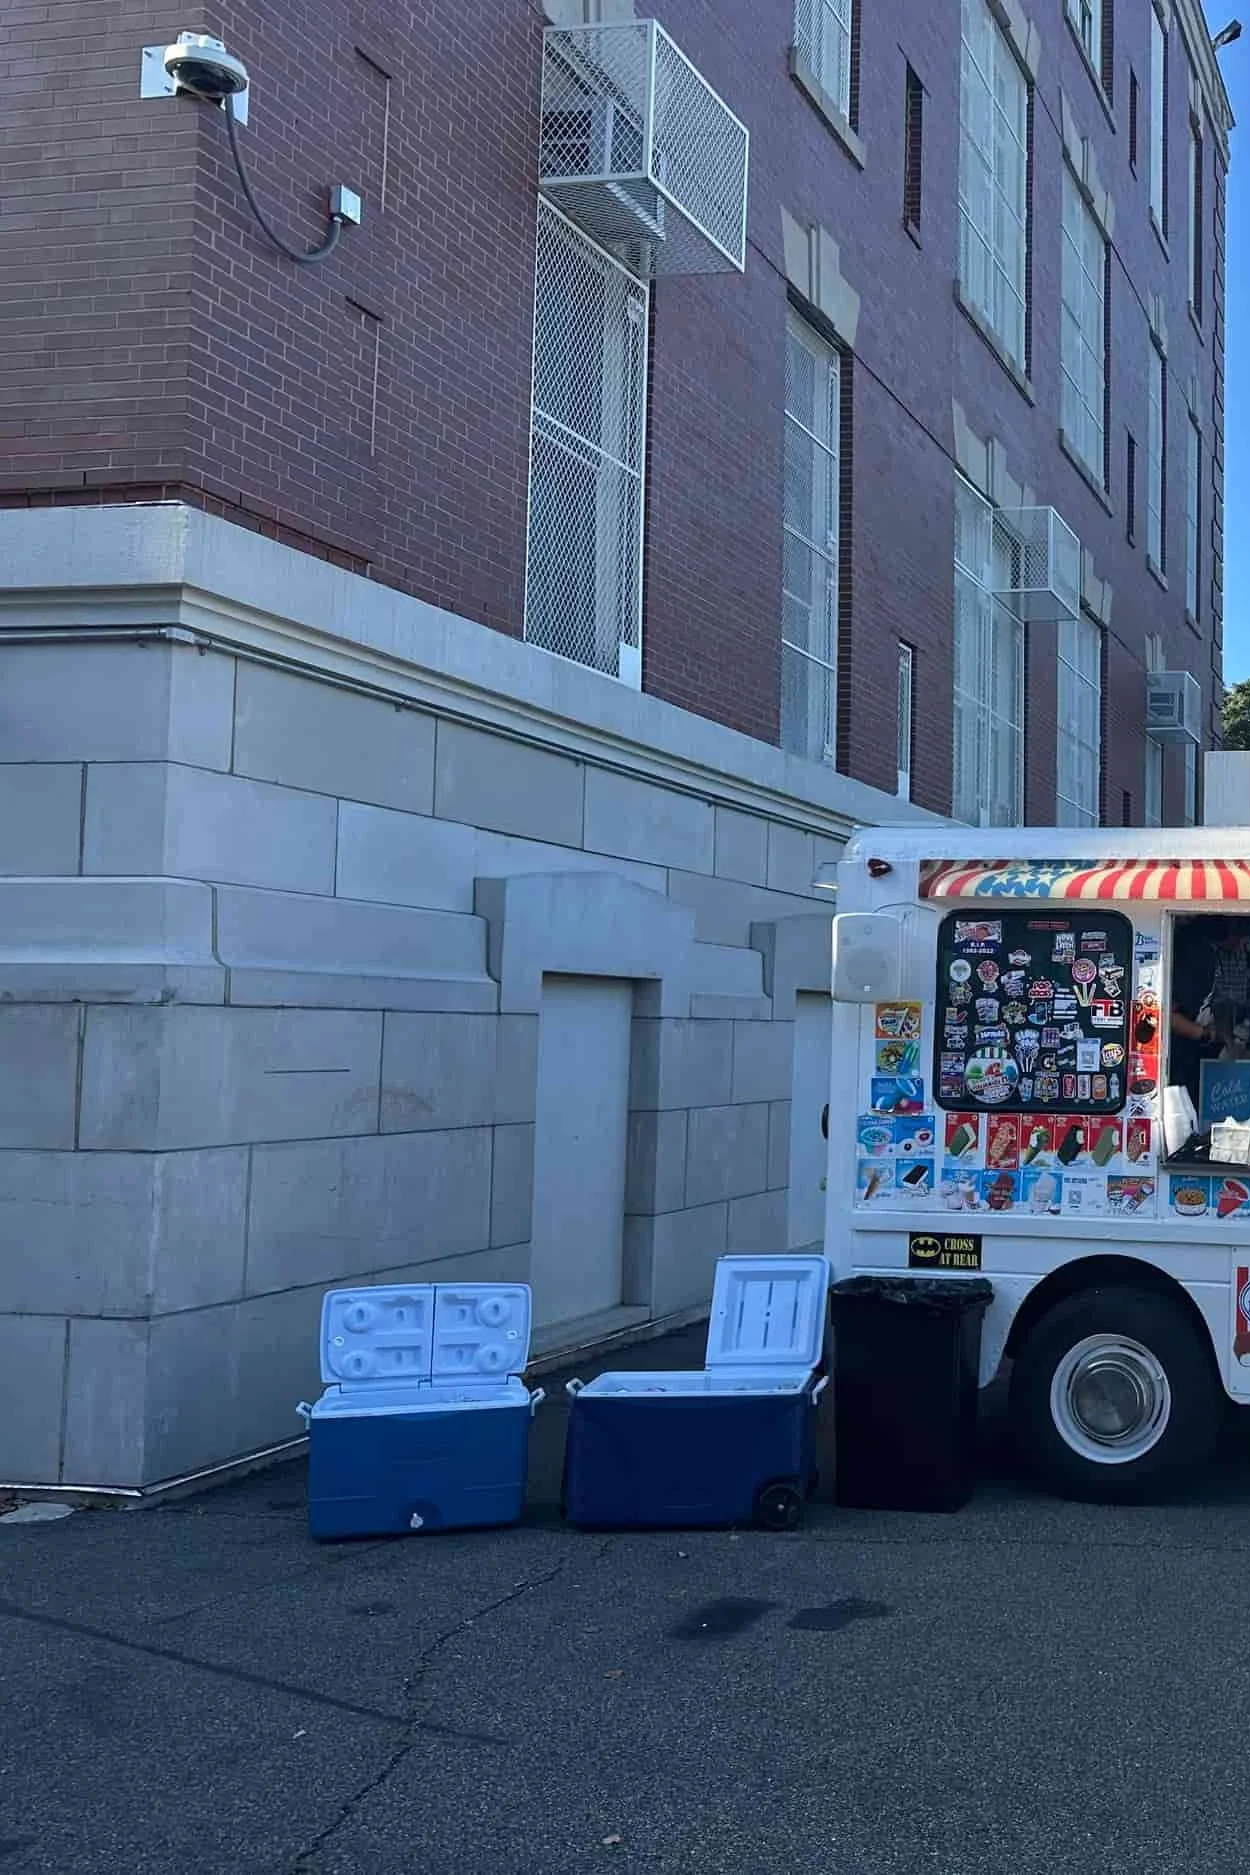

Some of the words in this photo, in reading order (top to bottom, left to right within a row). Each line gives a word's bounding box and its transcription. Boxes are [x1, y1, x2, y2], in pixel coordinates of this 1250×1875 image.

[1211, 1079, 1243, 1100] Cold
[944, 1238, 974, 1251] CROSS
[939, 1253, 951, 1265] AT
